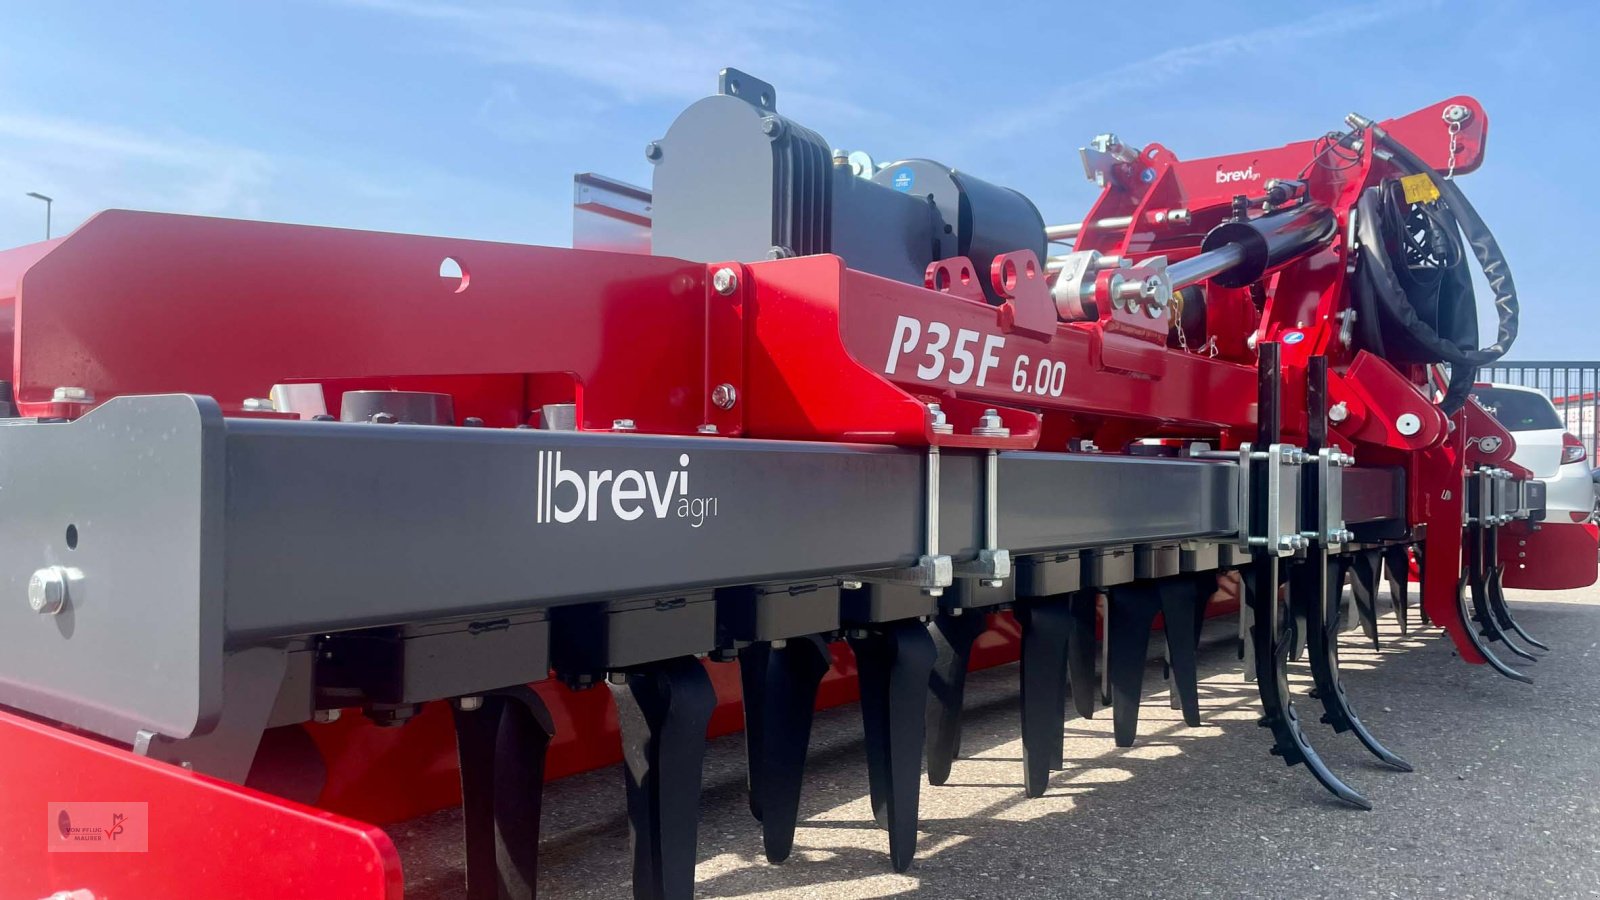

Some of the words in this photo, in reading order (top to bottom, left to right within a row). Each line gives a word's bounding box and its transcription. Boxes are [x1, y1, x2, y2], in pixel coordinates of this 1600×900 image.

[884, 315, 1006, 387] P35F
[1011, 354, 1067, 397] 6.00
[677, 497, 718, 528] agri
